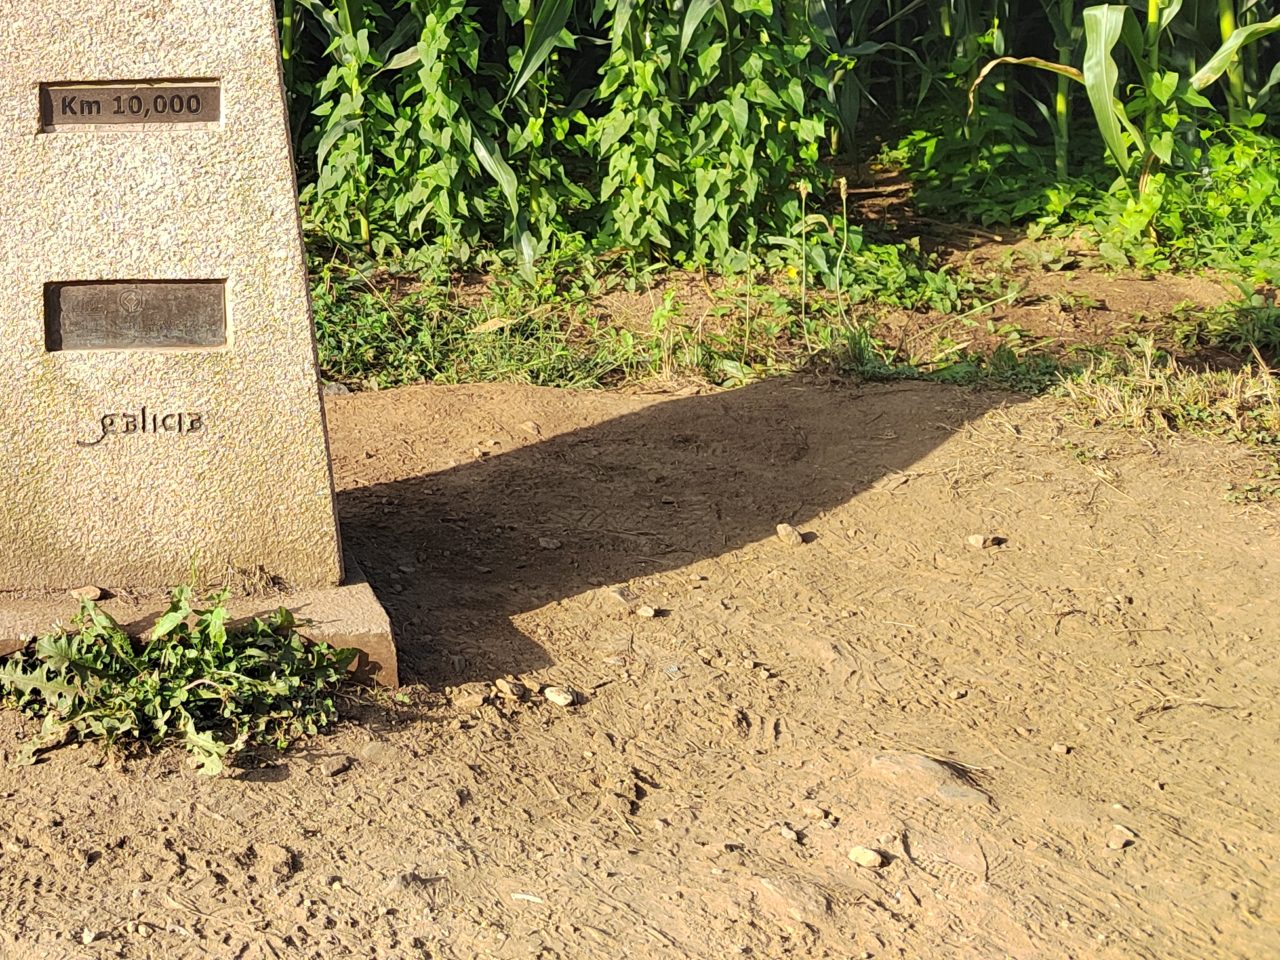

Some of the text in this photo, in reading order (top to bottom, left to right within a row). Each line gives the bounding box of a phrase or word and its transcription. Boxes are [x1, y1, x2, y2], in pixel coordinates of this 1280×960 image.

[61, 94, 202, 118] Km 10,000
[77, 406, 203, 446] galicia
